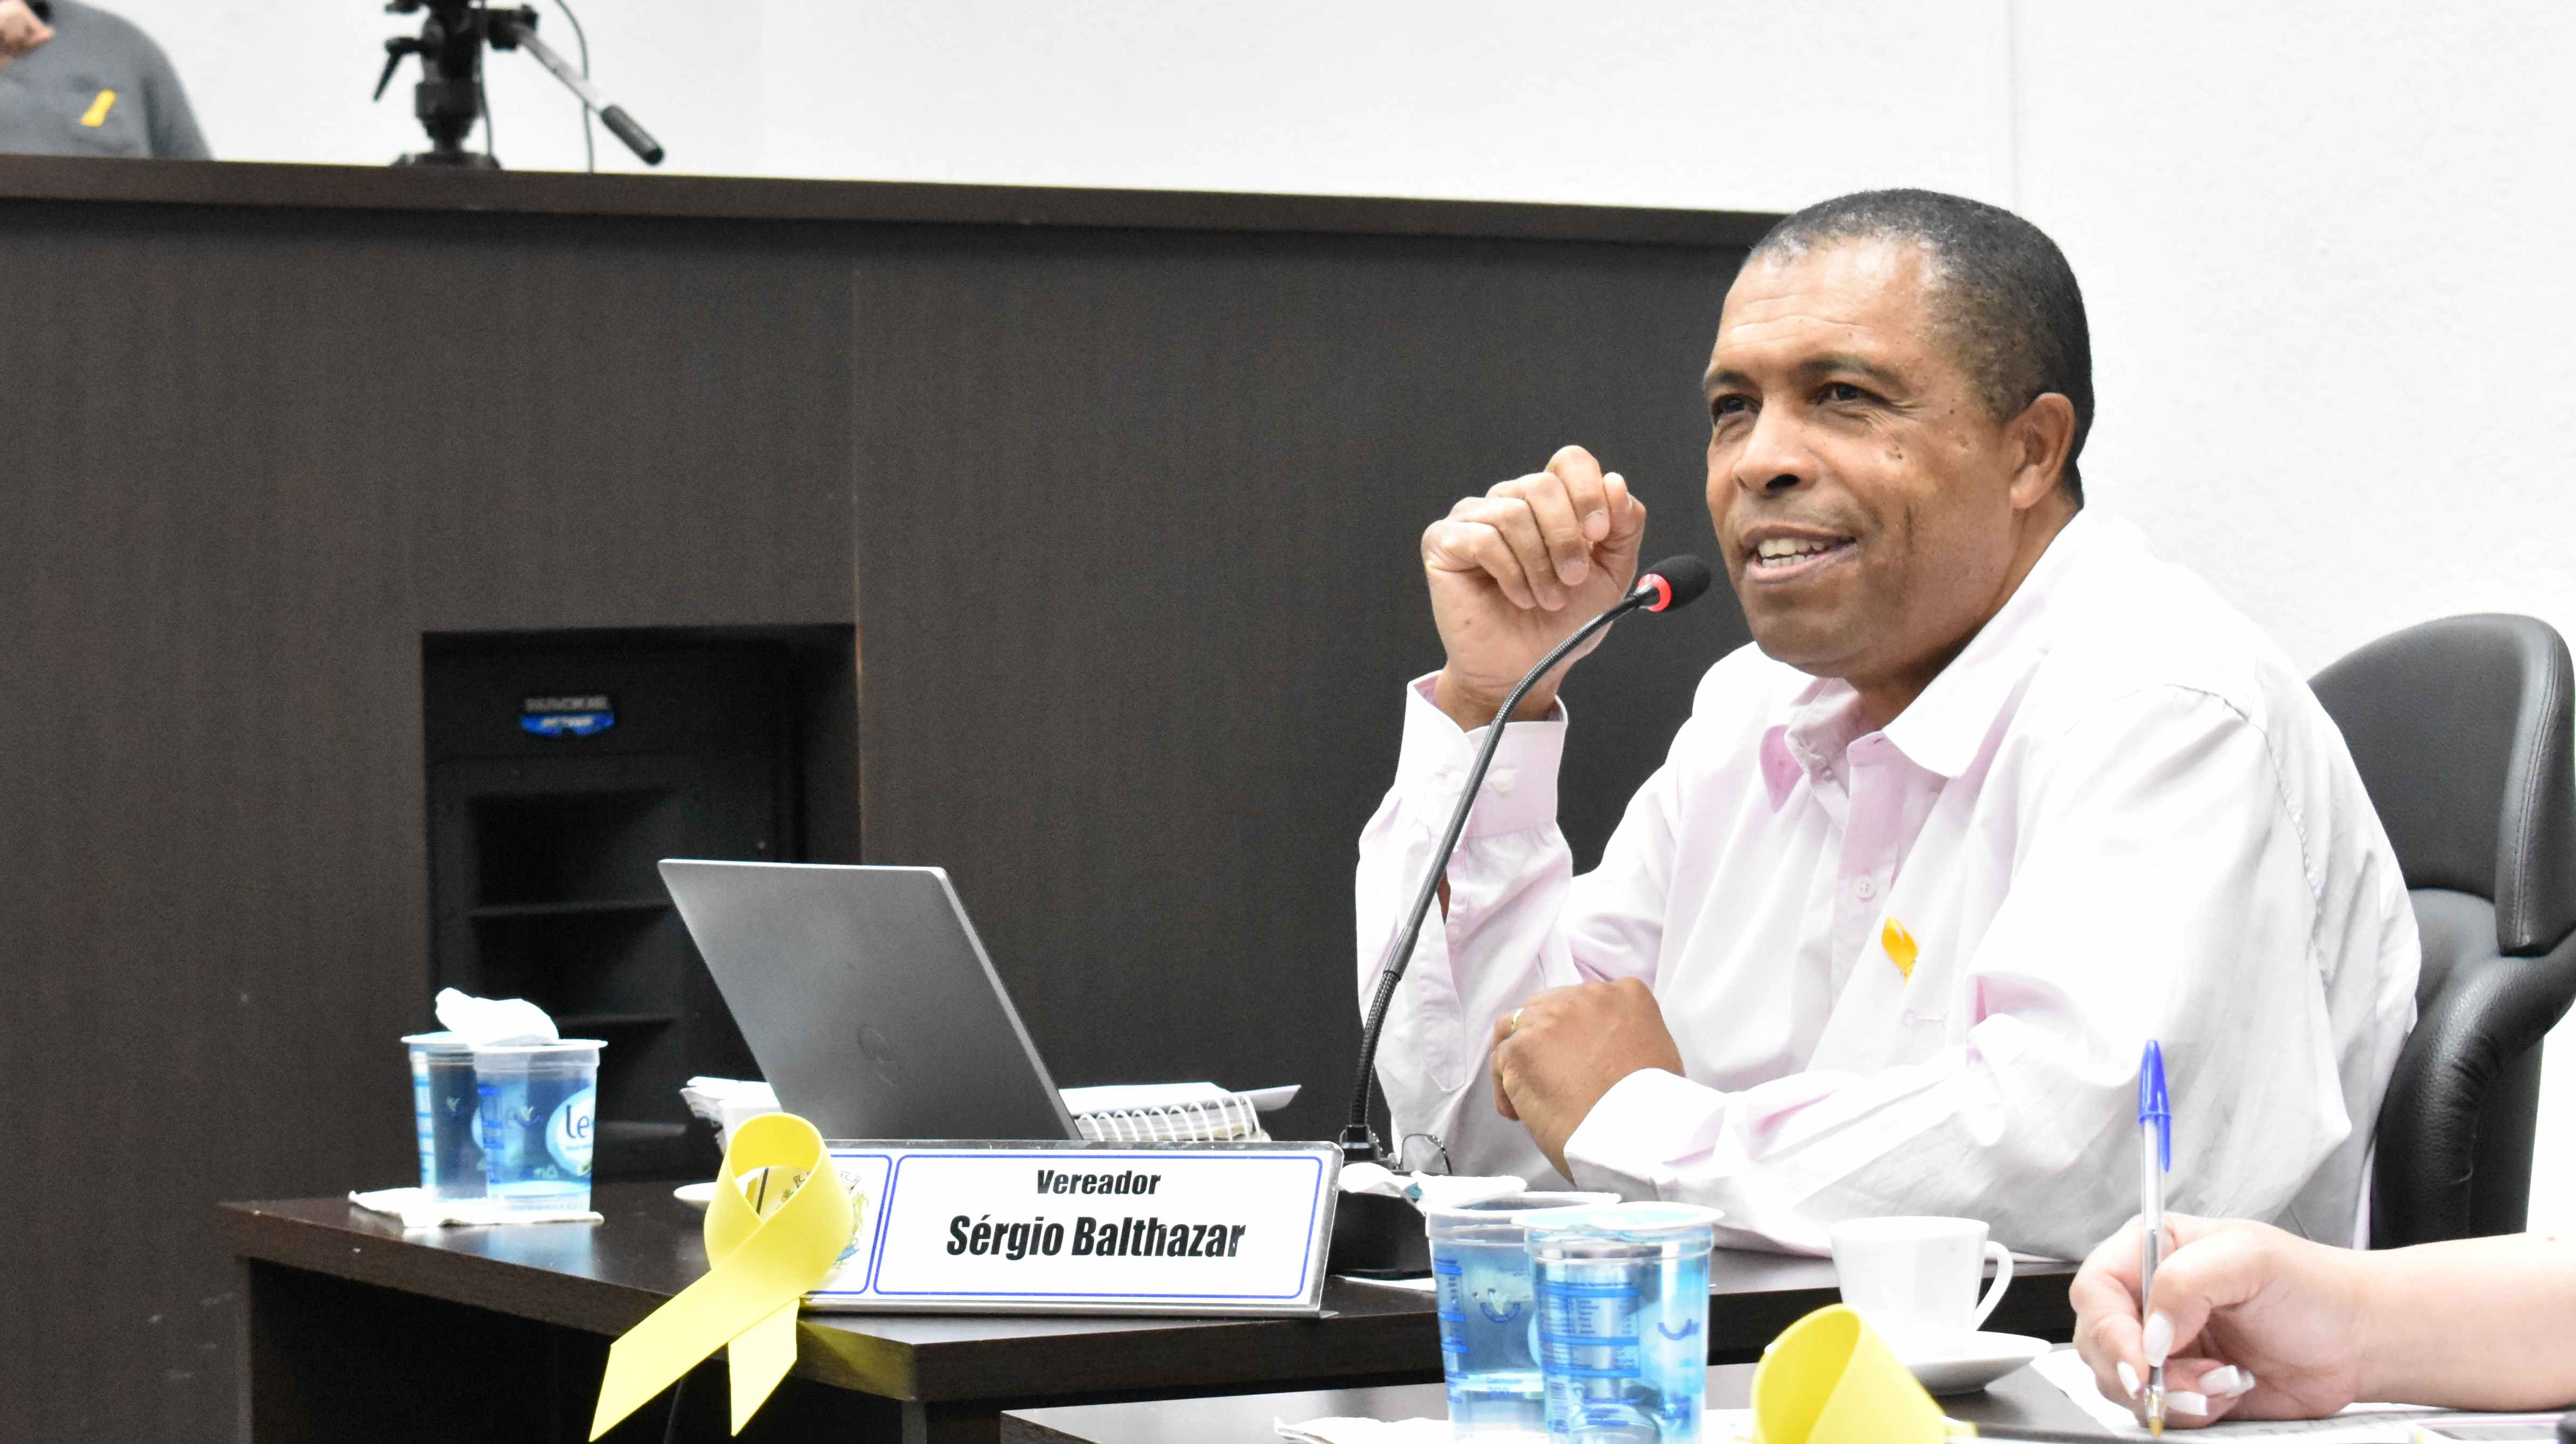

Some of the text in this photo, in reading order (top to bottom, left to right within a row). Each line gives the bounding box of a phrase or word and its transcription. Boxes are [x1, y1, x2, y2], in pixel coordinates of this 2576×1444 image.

[566, 1104, 593, 1138] le
[1037, 1169, 1161, 1195] Vereador
[946, 1214, 1246, 1260] Sérgio Balthazar
